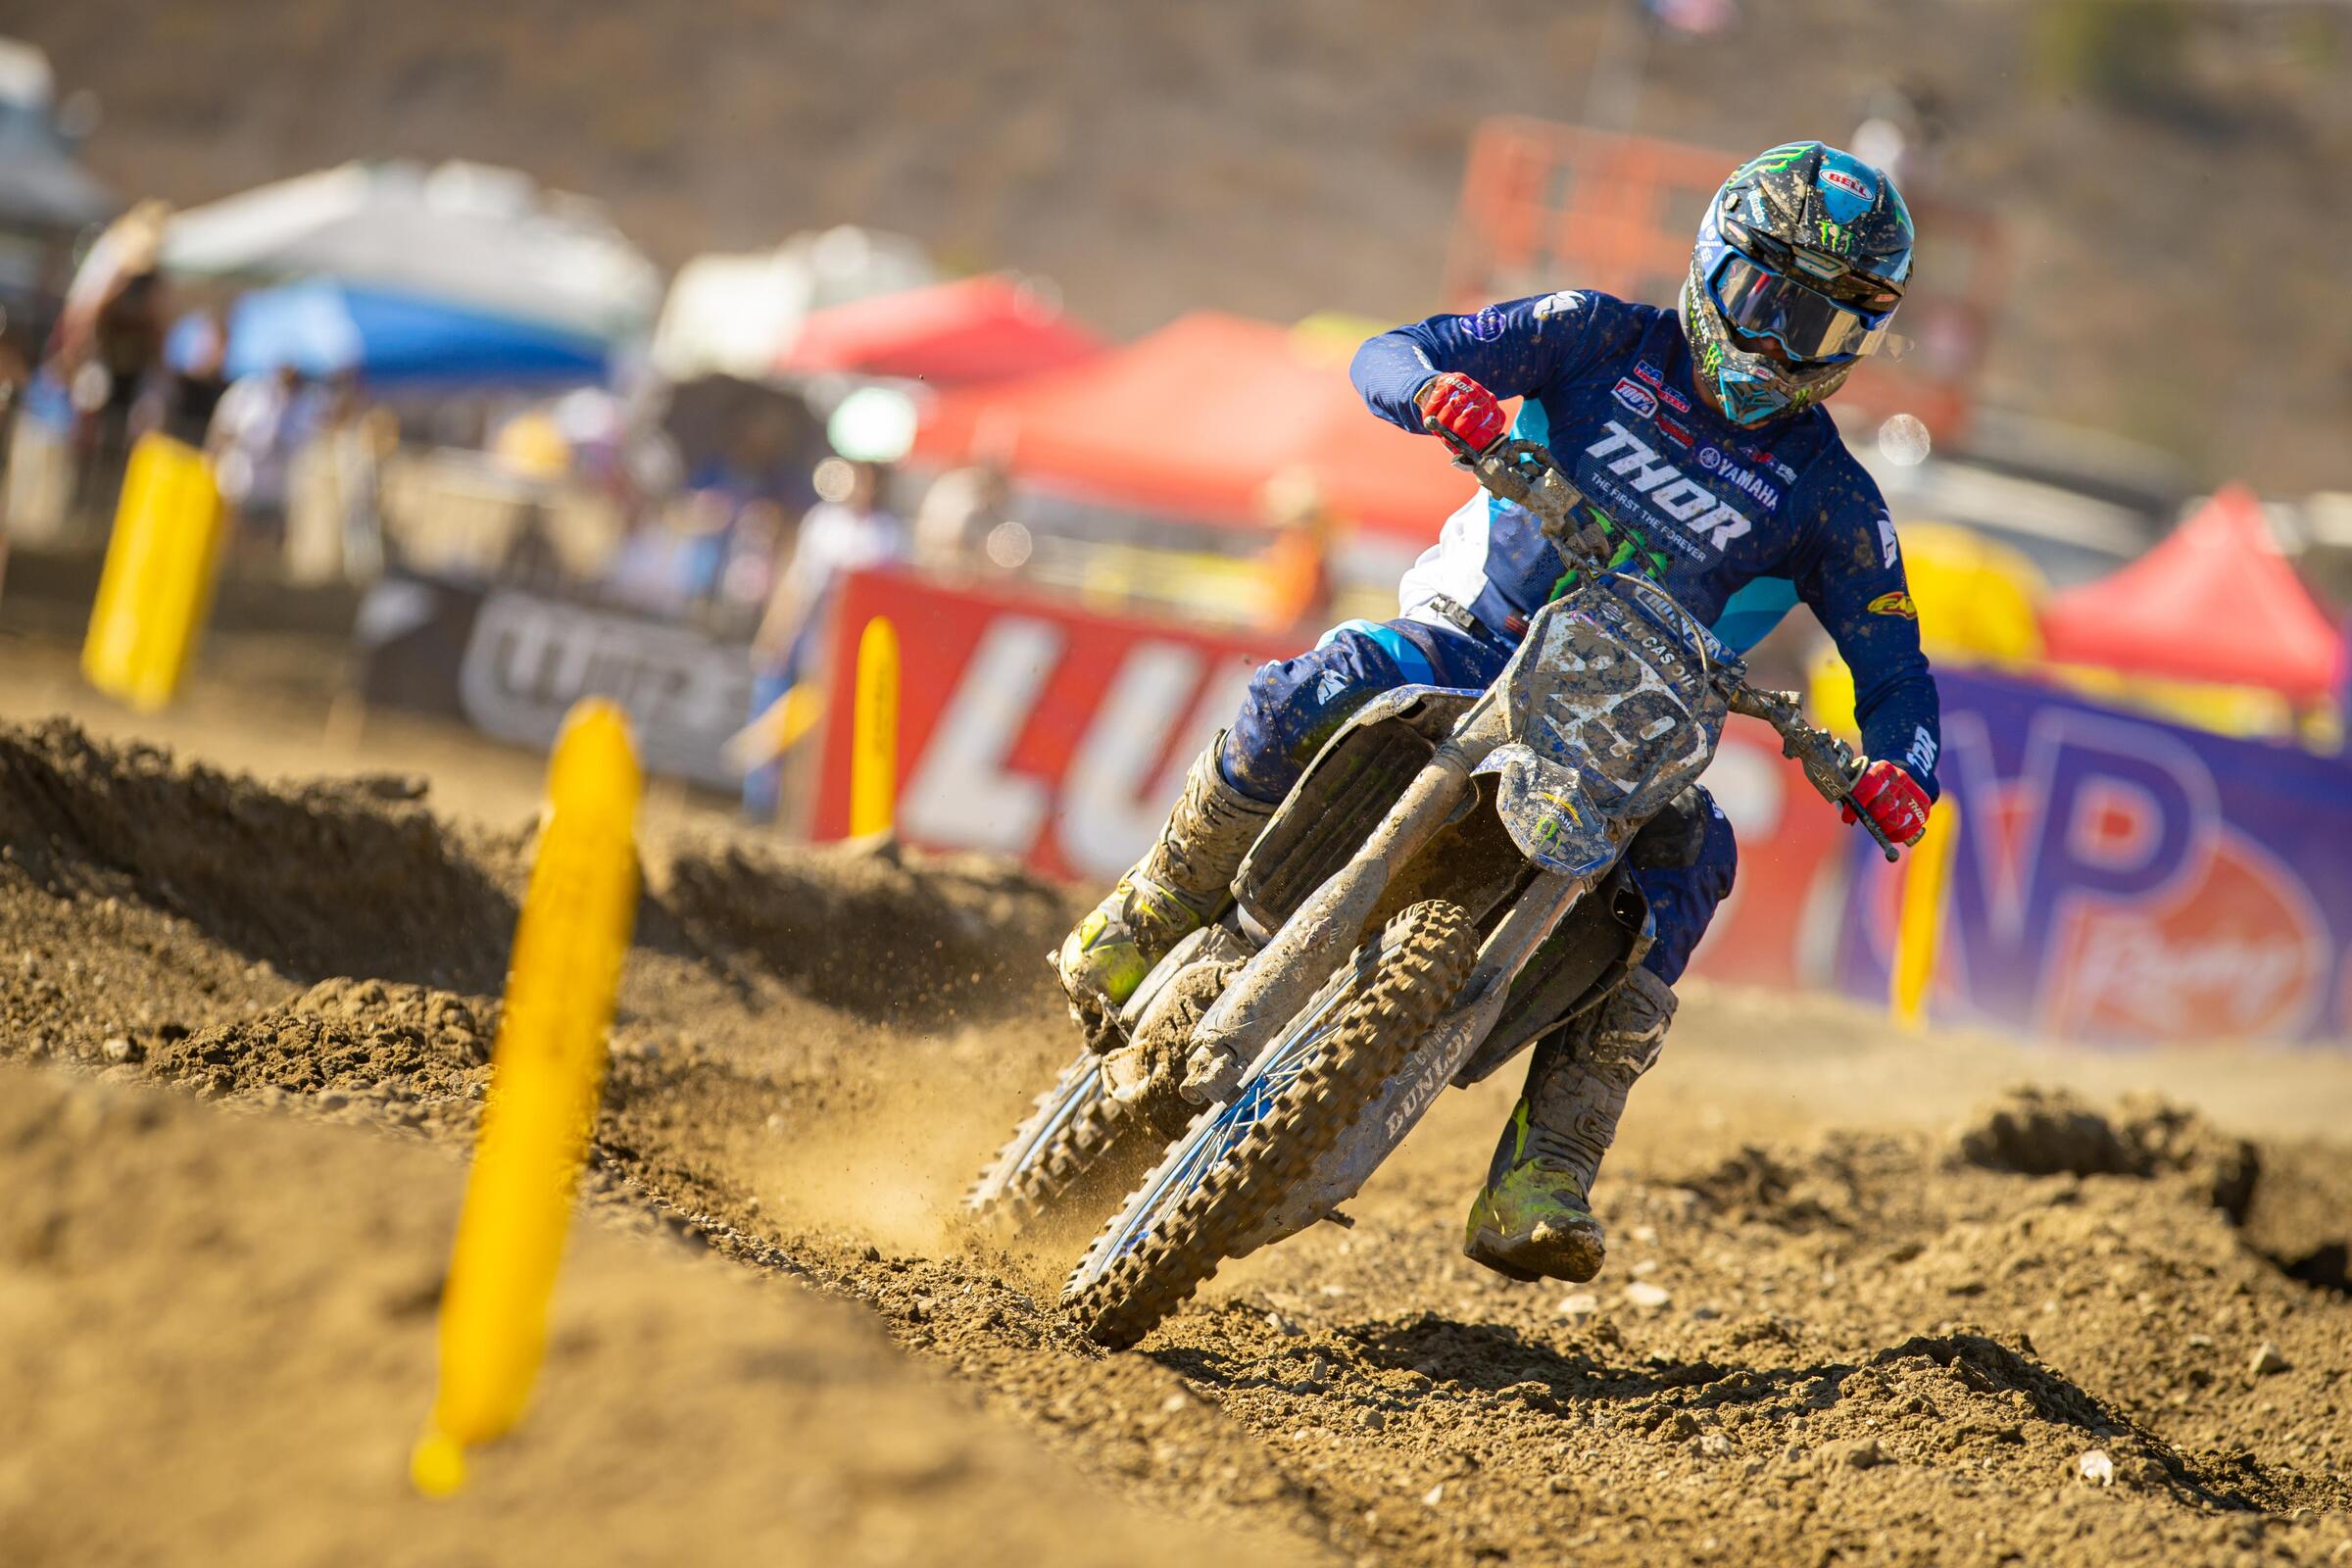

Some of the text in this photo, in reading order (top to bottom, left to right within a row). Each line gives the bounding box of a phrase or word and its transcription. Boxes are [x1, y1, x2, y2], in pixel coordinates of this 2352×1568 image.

[1829, 173, 1867, 197] BELL
[1617, 385, 1653, 412] 100%
[1585, 419, 1751, 552] THOR
[1718, 459, 1779, 511] YAMAHA
[1591, 472, 1706, 563] THE FIRST THE FOREVER
[1908, 799, 1926, 824] THOR
[1385, 1017, 1475, 1140] DUNLOP
